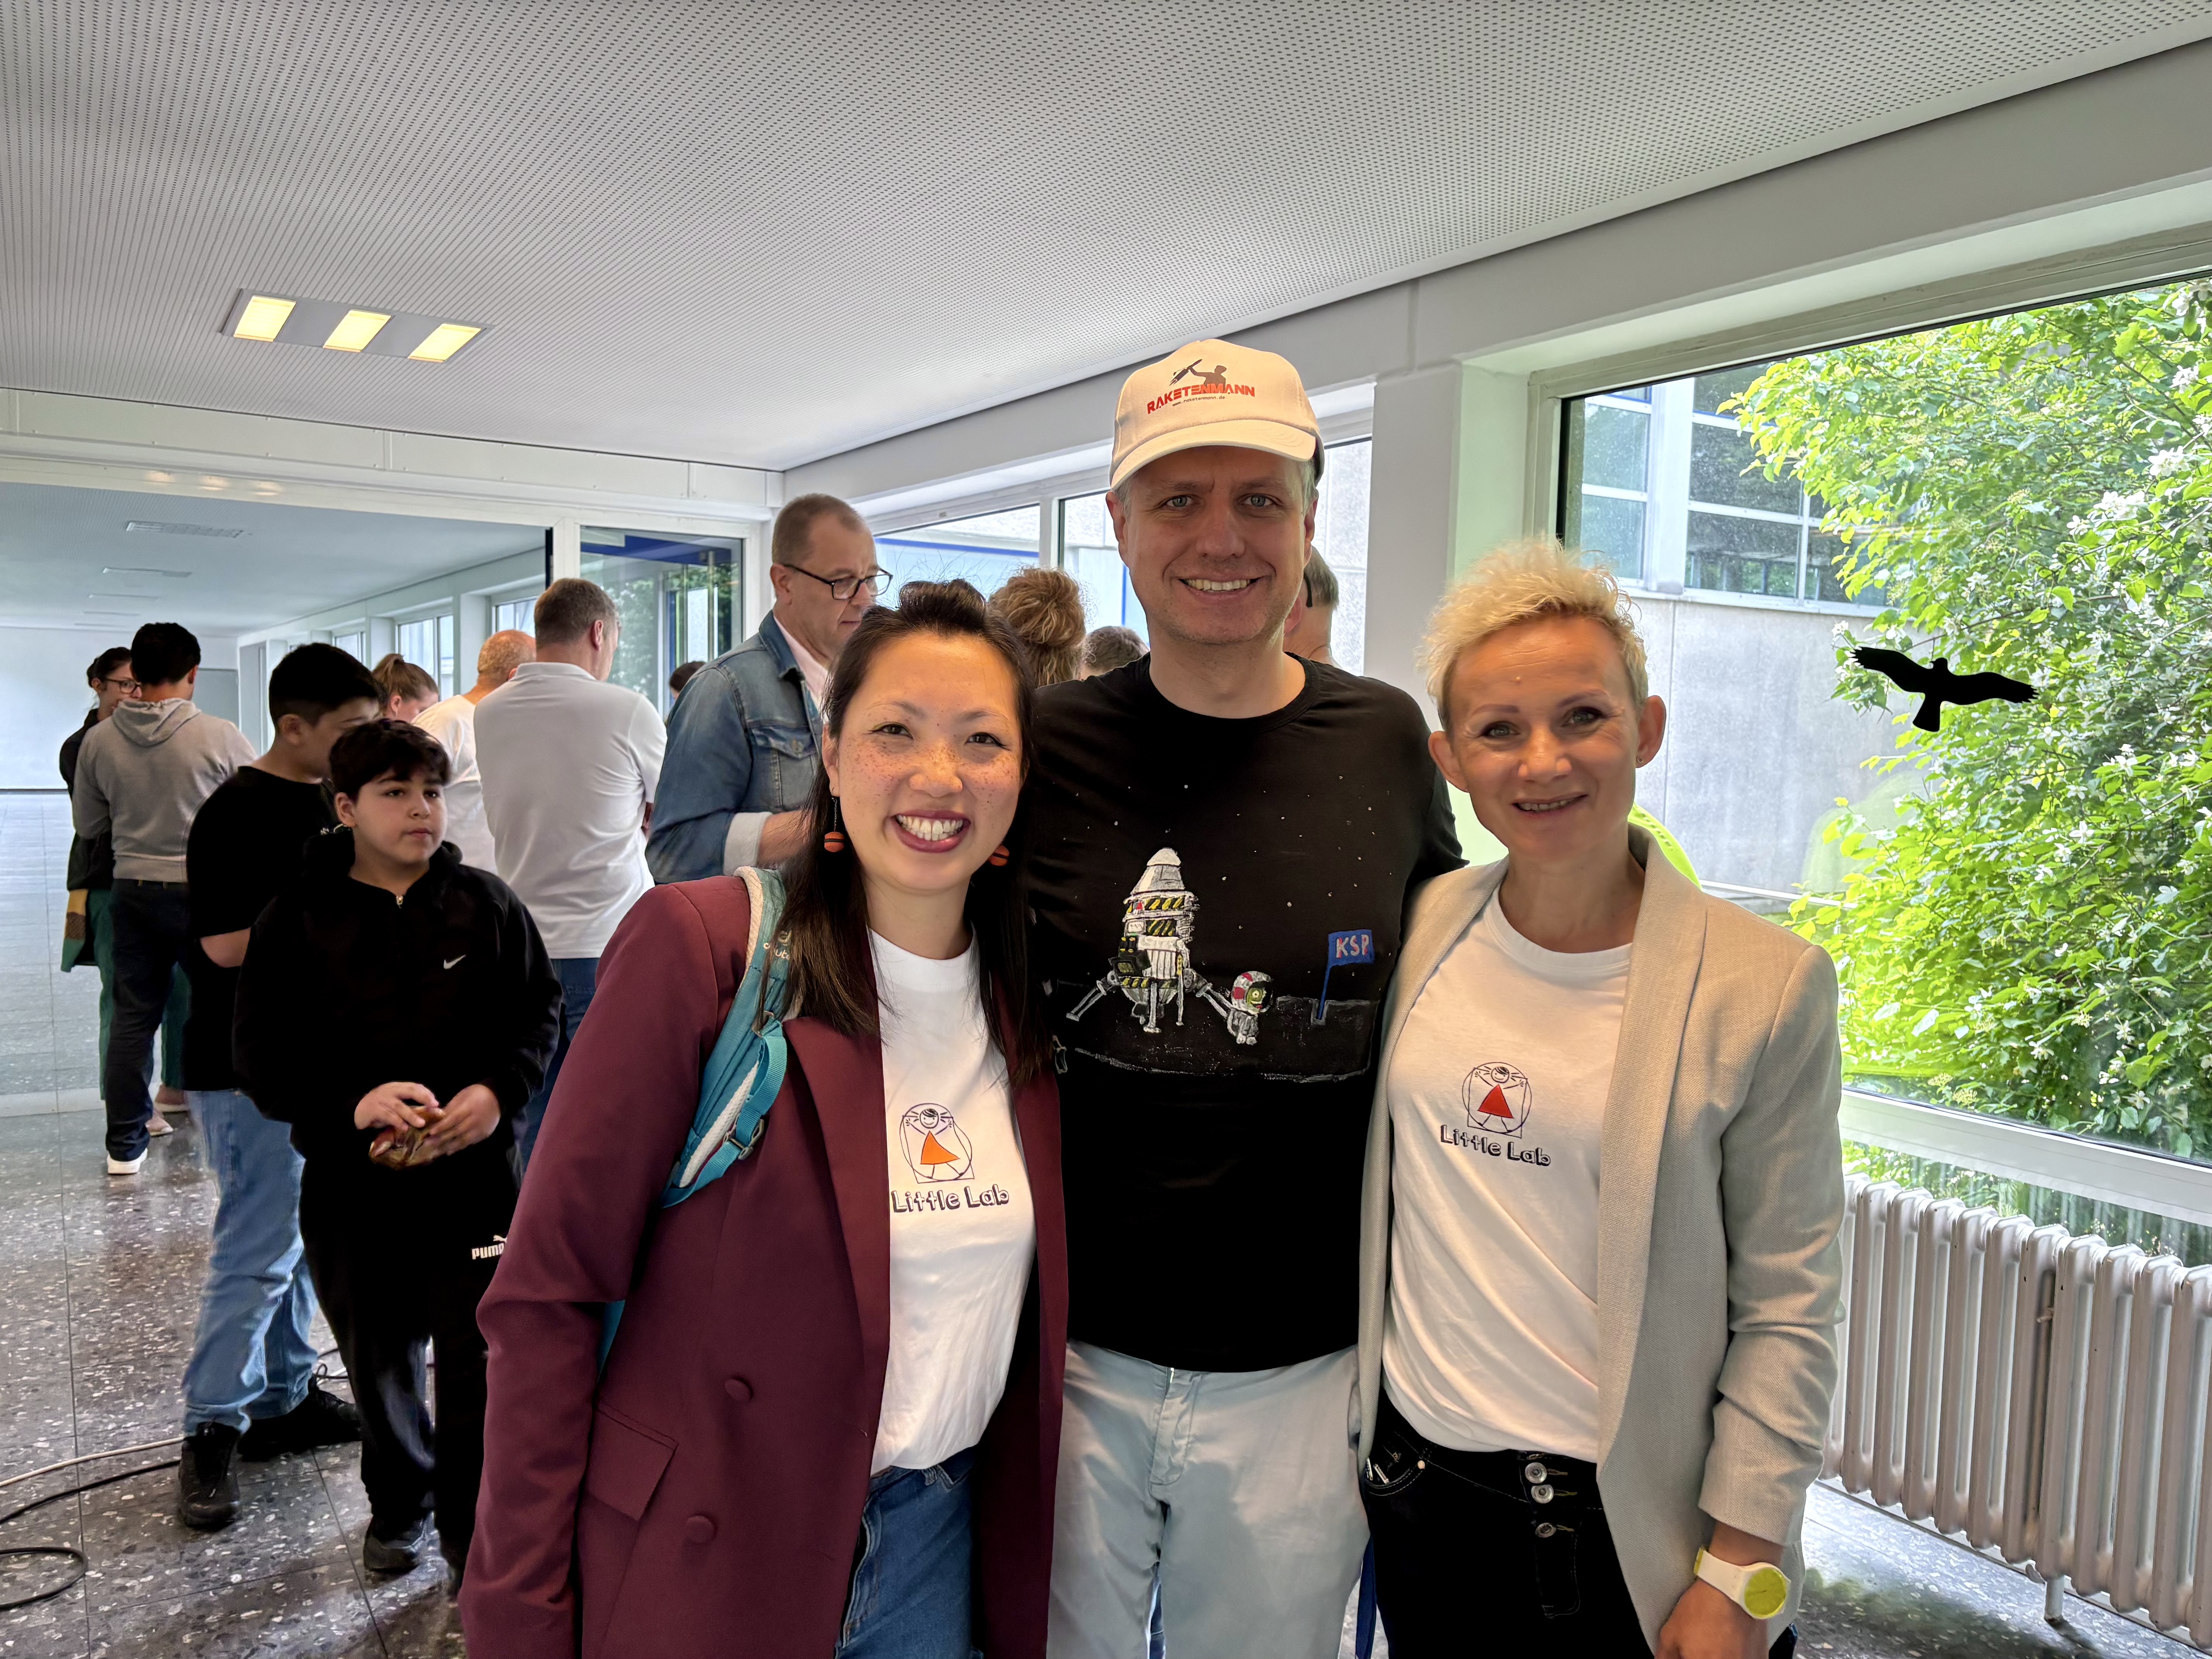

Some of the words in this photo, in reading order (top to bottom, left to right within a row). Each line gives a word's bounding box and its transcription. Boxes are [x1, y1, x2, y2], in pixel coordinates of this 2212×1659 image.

[1147, 383, 1255, 414] RAKETENMANN
[1336, 934, 1369, 959] KSP
[1440, 1125, 1501, 1156] Little
[1508, 1141, 1551, 1166] Lab
[891, 1190, 961, 1213] Little
[964, 1184, 1010, 1208] Lab
